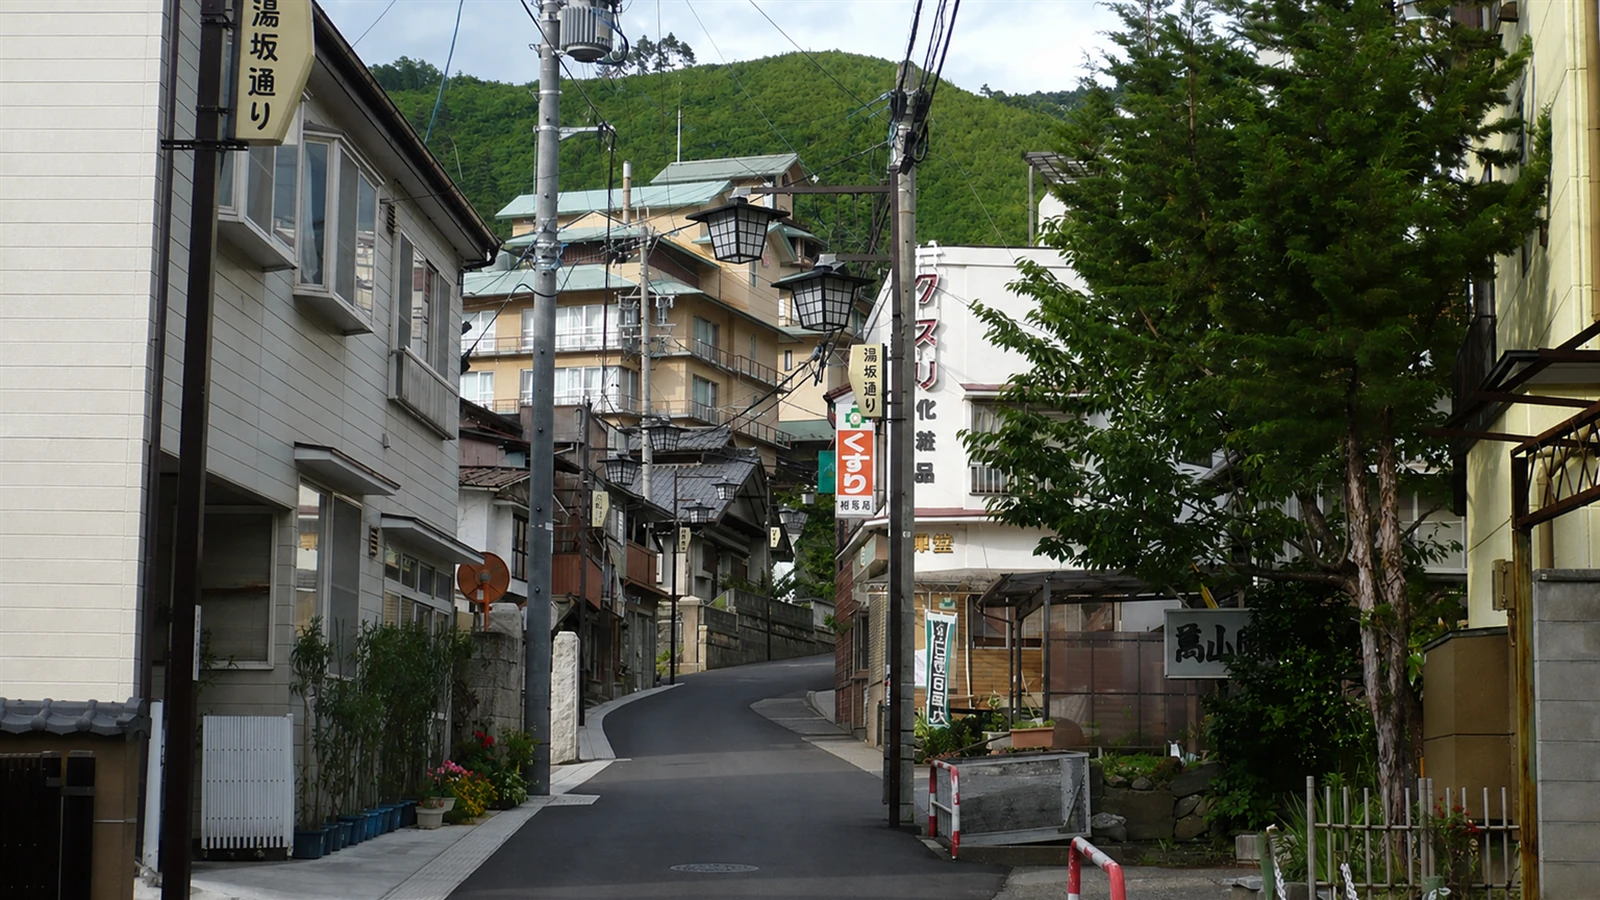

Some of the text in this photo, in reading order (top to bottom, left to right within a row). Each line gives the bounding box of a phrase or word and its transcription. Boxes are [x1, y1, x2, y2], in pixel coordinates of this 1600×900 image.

[248, 0, 280, 130] 湯坂通り
[915, 273, 938, 390] クスリ
[863, 347, 877, 413] 湯坂通り
[841, 431, 870, 494] くすり
[914, 398, 937, 484] 化粧品
